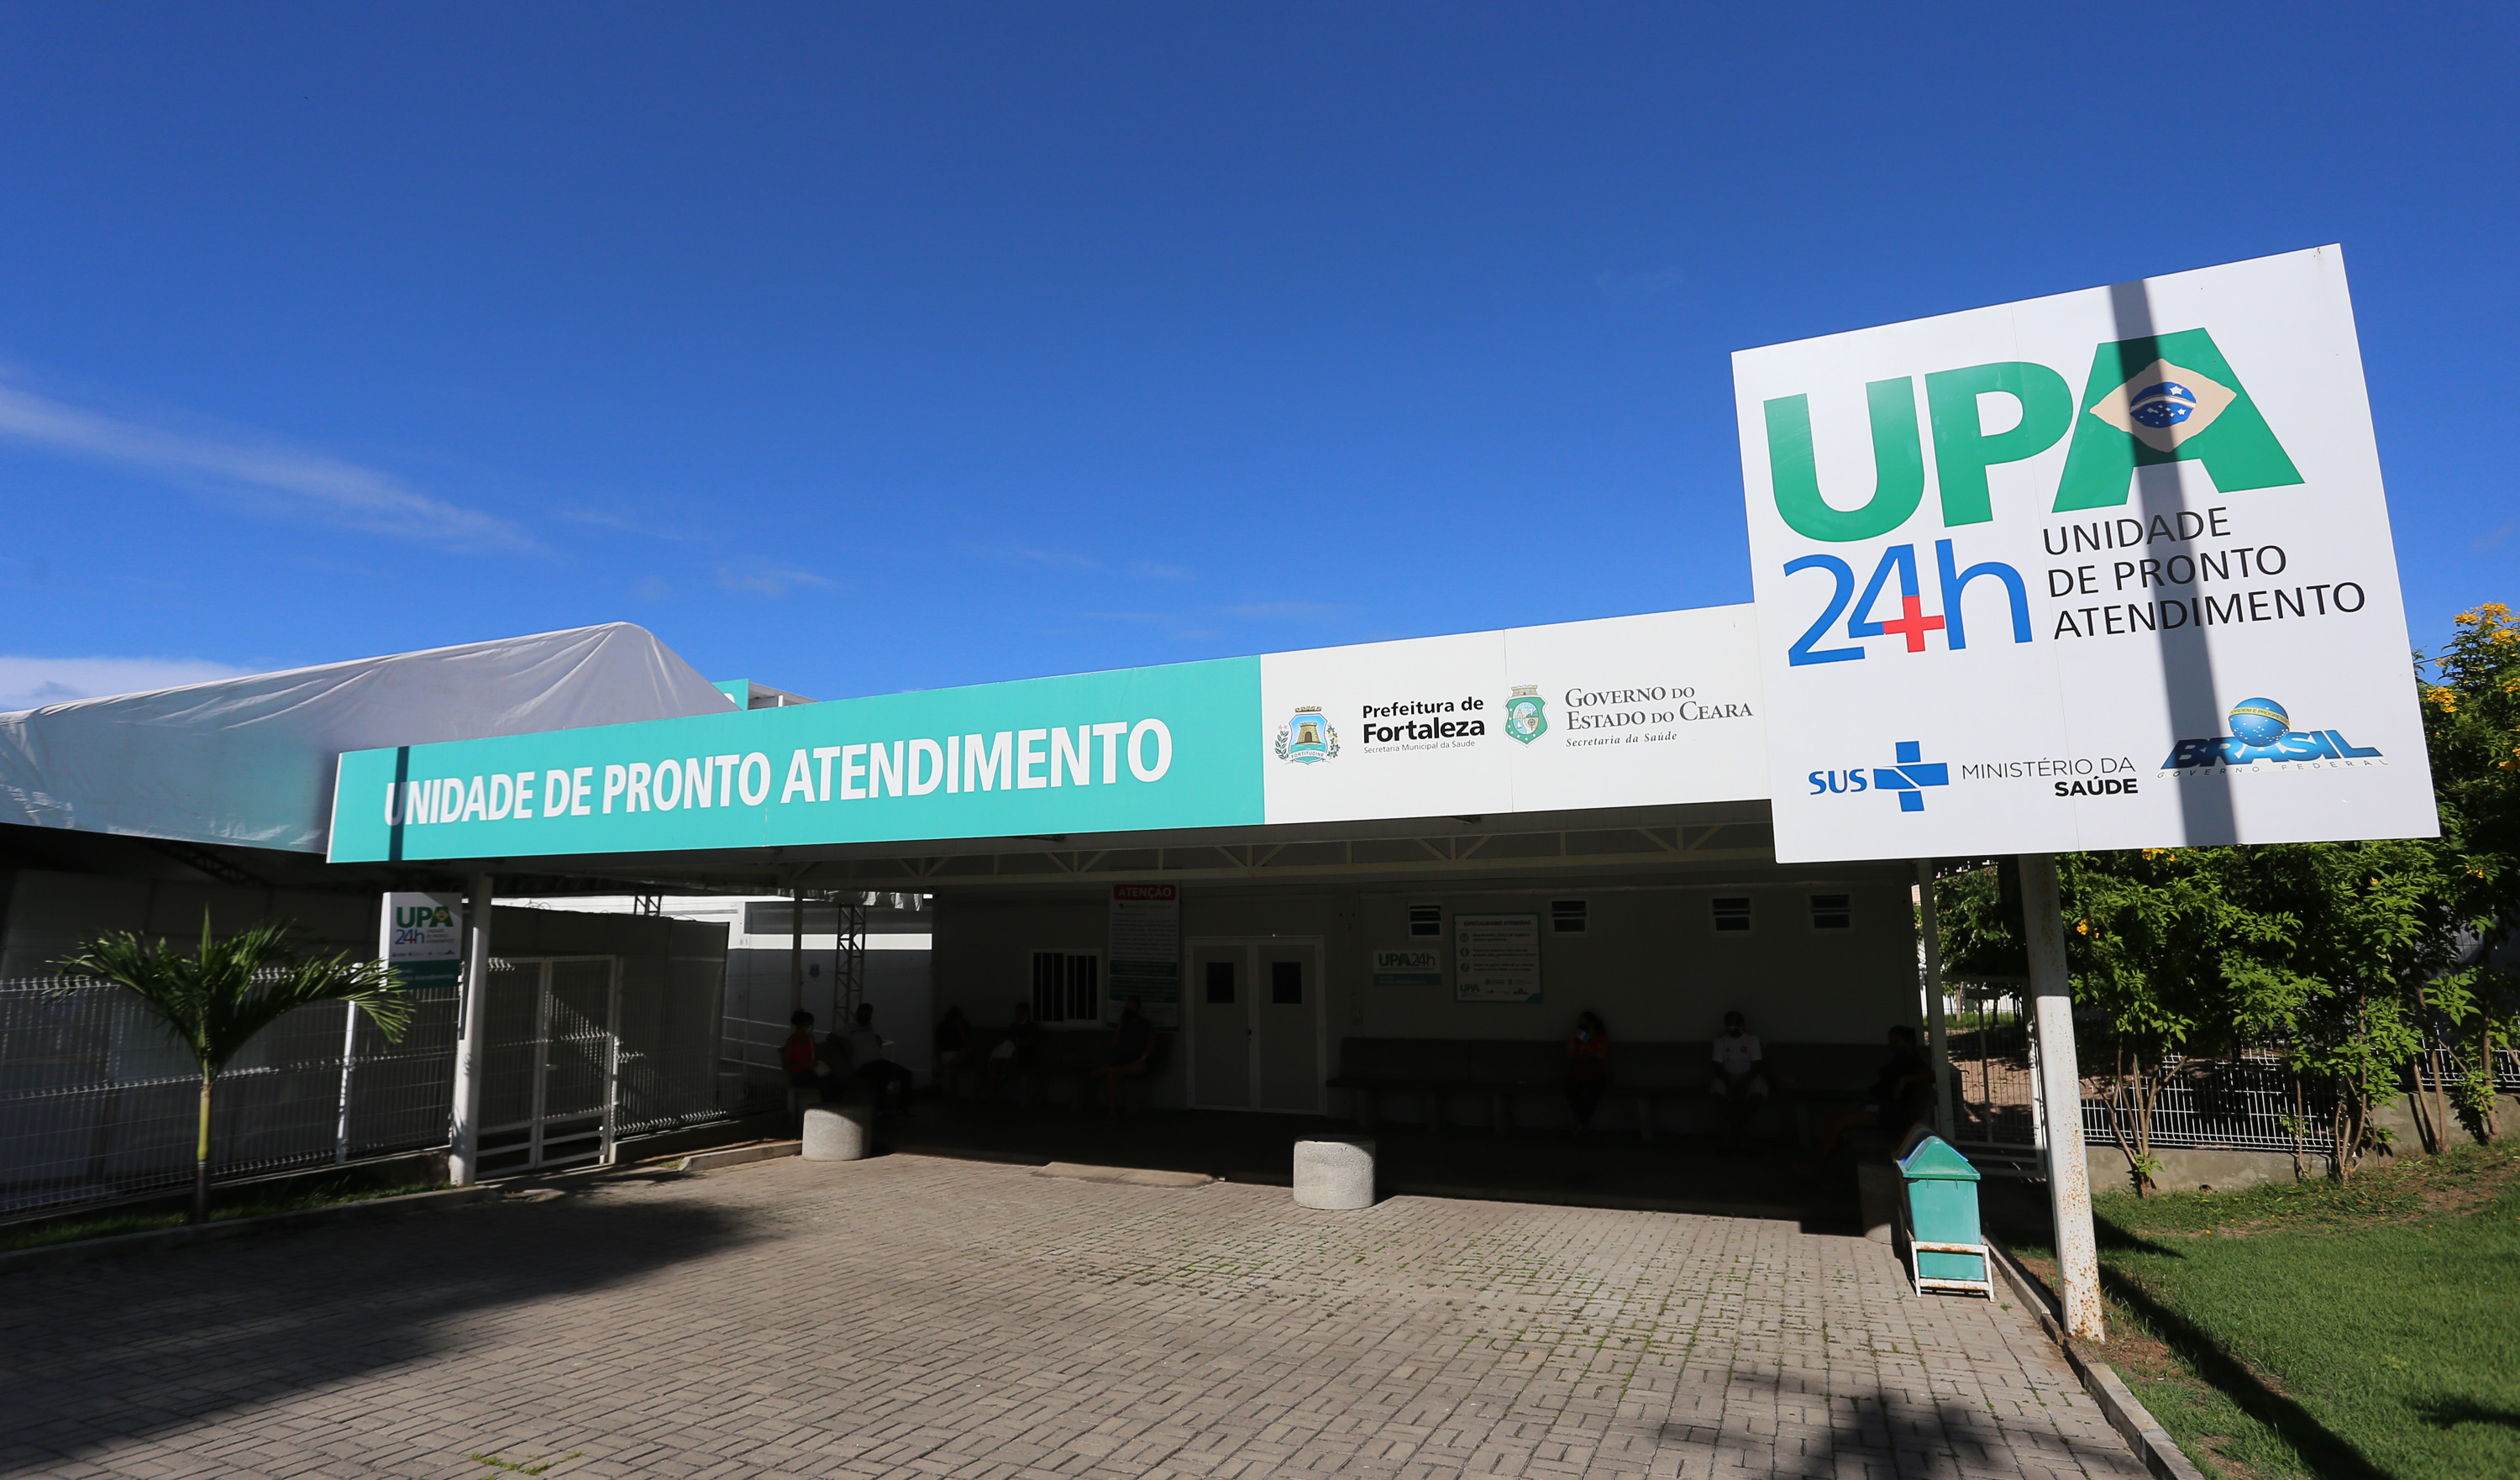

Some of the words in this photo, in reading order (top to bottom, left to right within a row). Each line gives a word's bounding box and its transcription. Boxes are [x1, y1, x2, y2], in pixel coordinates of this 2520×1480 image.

[1763, 327, 2305, 542] UPA
[2043, 506, 2231, 555] UNIDADE
[2048, 564, 2098, 598] DE
[2113, 544, 2287, 591] PRONTO
[1782, 538, 2033, 666] 24h
[2054, 581, 2365, 640] ATENDIMENTO
[1362, 700, 1455, 719] Prefeitura
[1461, 696, 1484, 711] de
[1565, 686, 1667, 707] GOVERNO
[1363, 716, 1485, 743] Fortaleza
[1567, 711, 1646, 731] ESTADO
[1363, 744, 1399, 753] Secretaria
[1401, 742, 1438, 753] Municipal
[1452, 739, 1475, 748] Saude
[1566, 735, 1620, 748] Secretaria
[1625, 733, 1639, 743] da
[1644, 732, 1677, 743] Saúde
[2160, 729, 2384, 769] BRASIL
[385, 770, 536, 826] UNIDADE
[543, 764, 593, 818] DE
[601, 751, 771, 815] PRONTO
[780, 716, 1173, 805] ATENDIMENTO
[1961, 757, 2093, 779] MINISTÉRIO
[2101, 756, 2136, 774] DA
[2157, 765, 2260, 779] GOVERNO
[2281, 758, 2389, 771] FEDERAL
[1808, 769, 1868, 795] SUS
[2054, 776, 2139, 797] SAÚDE
[1118, 885, 1172, 900] ATENÇÃO
[396, 906, 454, 928] UPA
[395, 928, 425, 945] 24h
[1460, 984, 1480, 992] UPA
